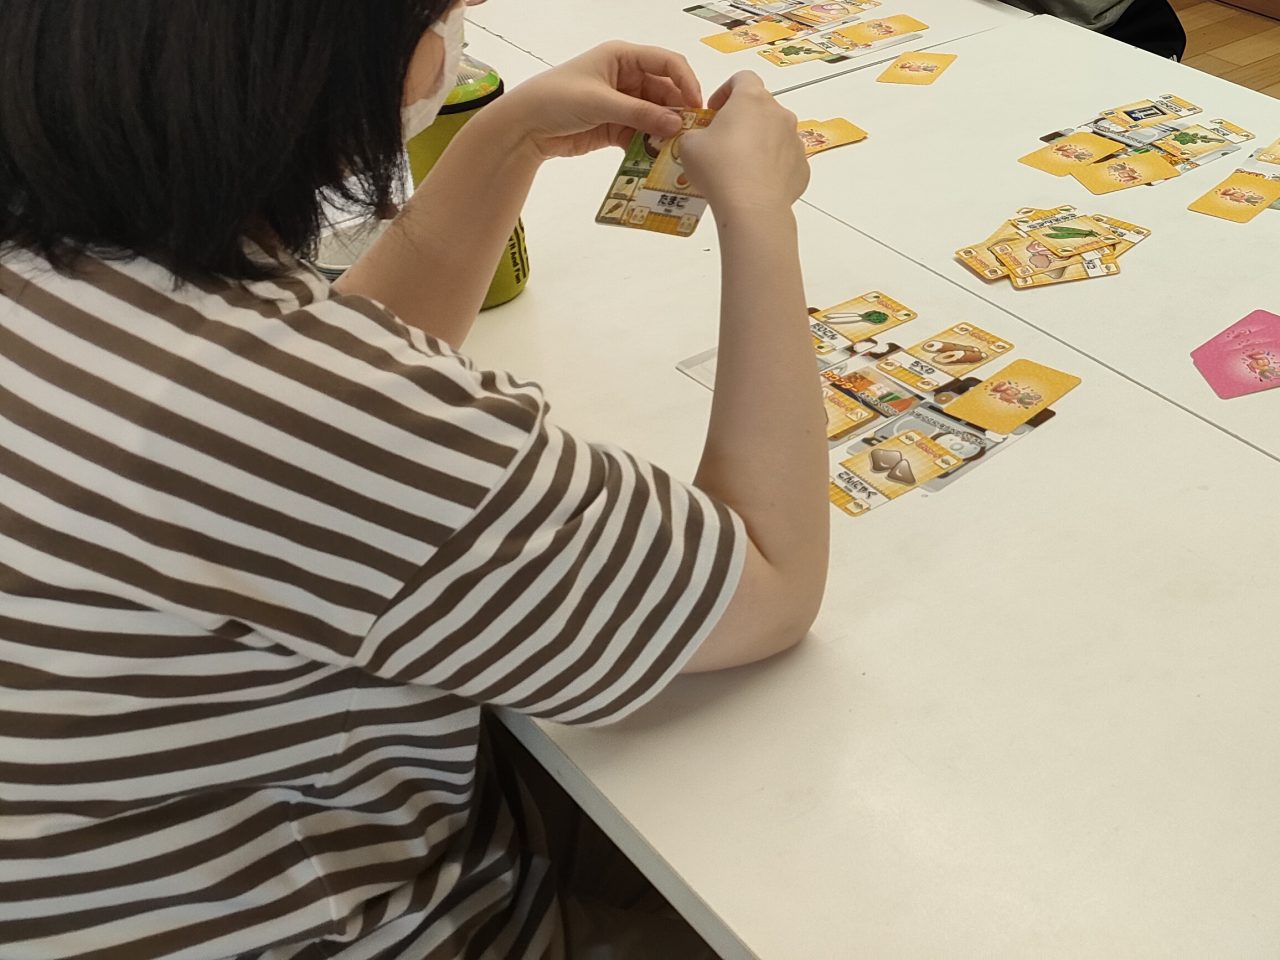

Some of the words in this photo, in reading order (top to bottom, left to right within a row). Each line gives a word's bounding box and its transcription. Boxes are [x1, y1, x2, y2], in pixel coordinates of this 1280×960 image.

[658, 193, 690, 208] たまご
[837, 470, 878, 500] こんにゃく
